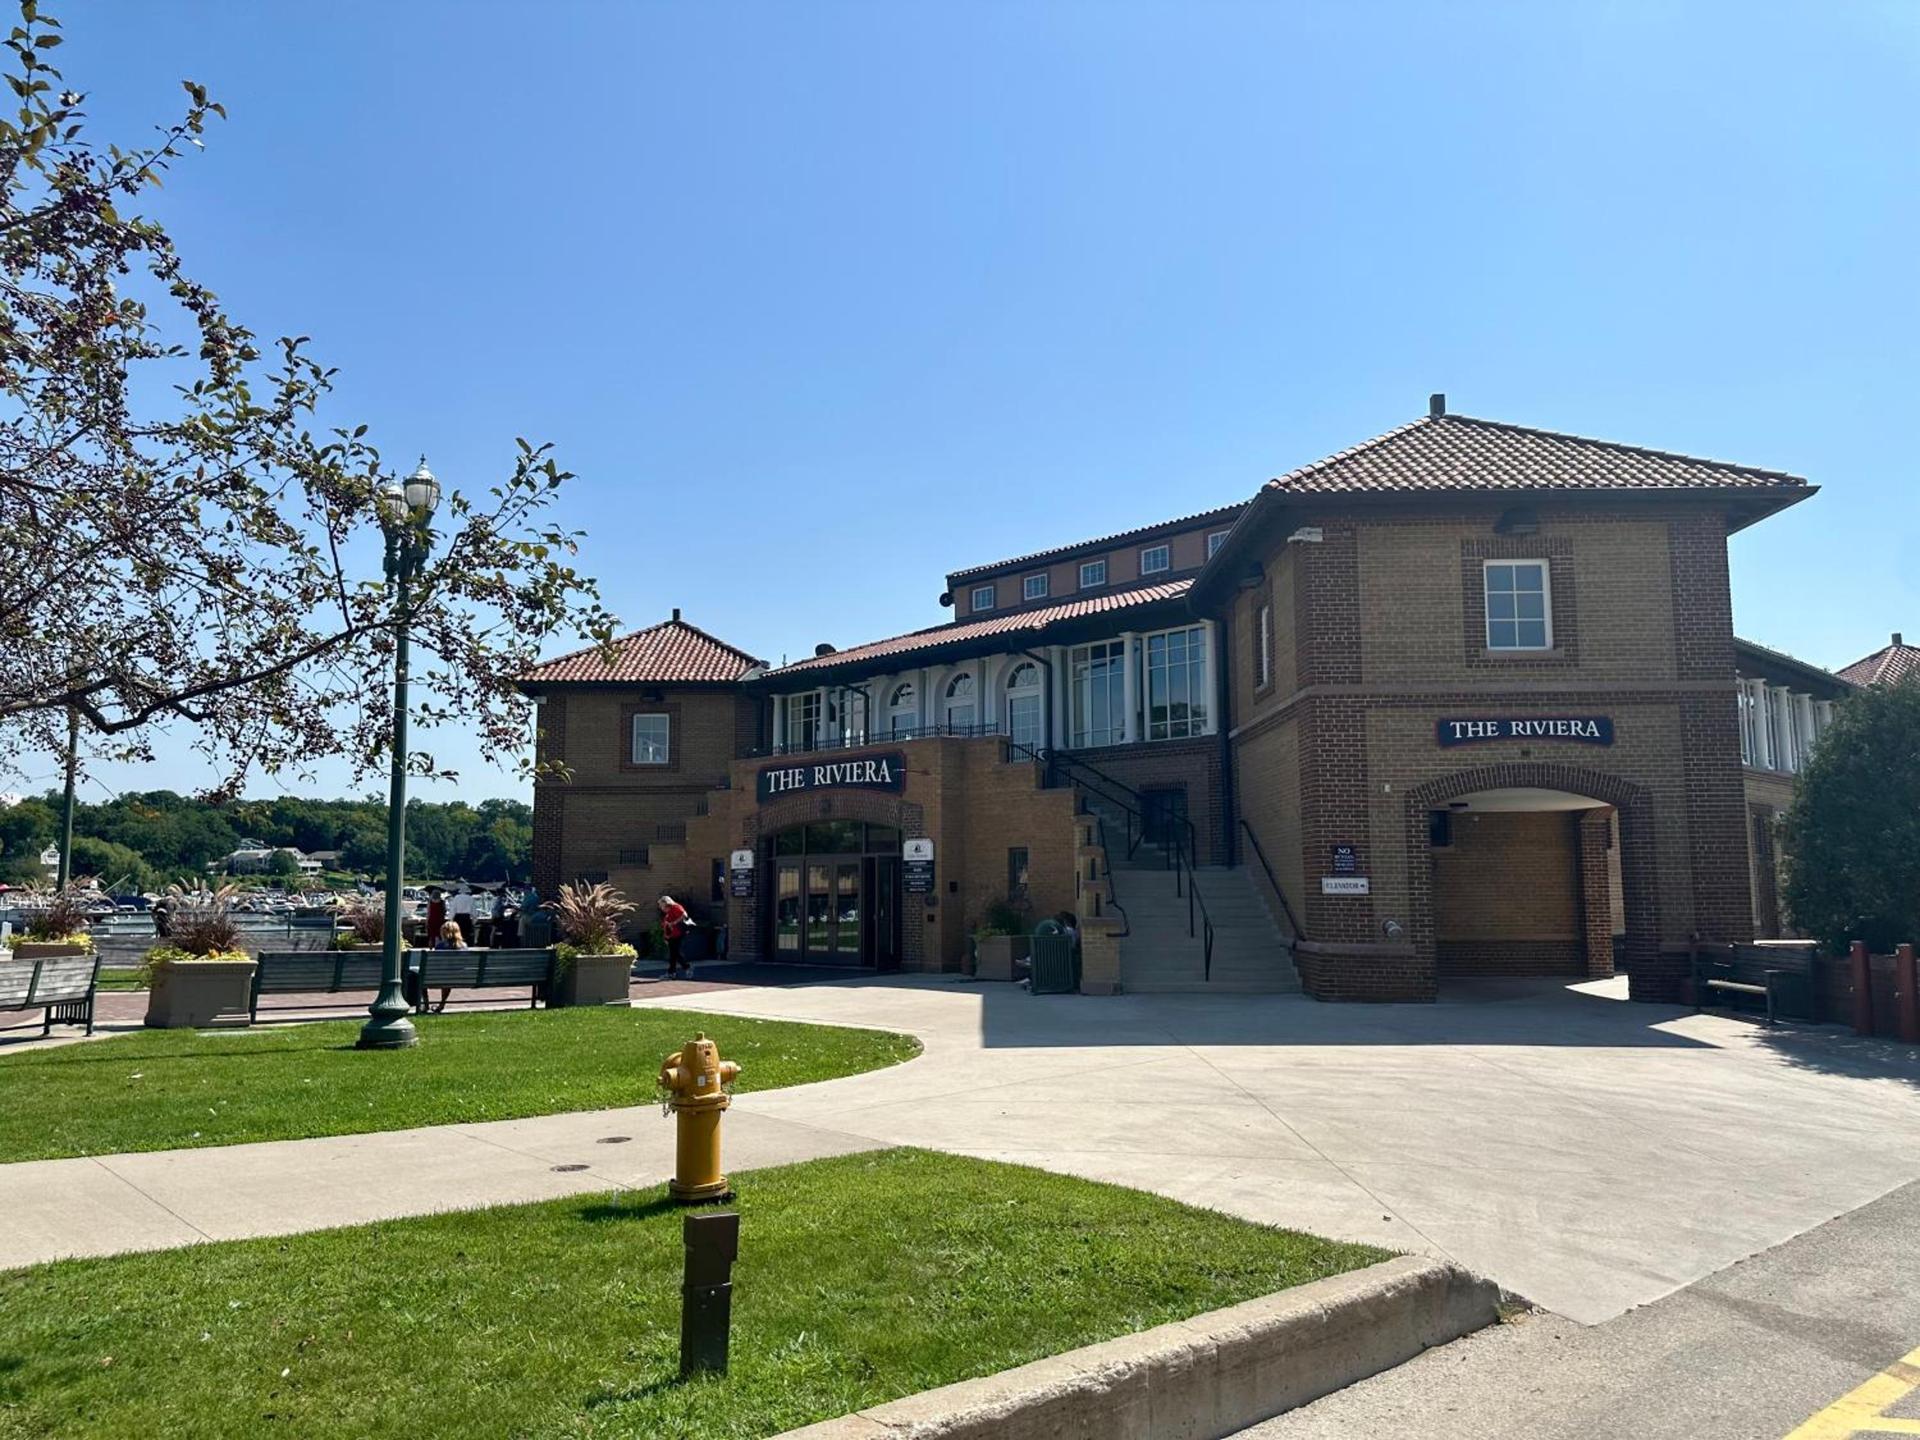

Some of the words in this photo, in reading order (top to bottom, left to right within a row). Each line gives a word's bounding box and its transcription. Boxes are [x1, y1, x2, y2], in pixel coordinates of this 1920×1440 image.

[1450, 721, 1500, 738] THE
[1511, 720, 1601, 737] RIVIERA
[766, 768, 805, 793] THE
[813, 759, 892, 786] RIVIERA
[1337, 847, 1351, 855] NO
[1325, 882, 1359, 890] ELEVATOR
